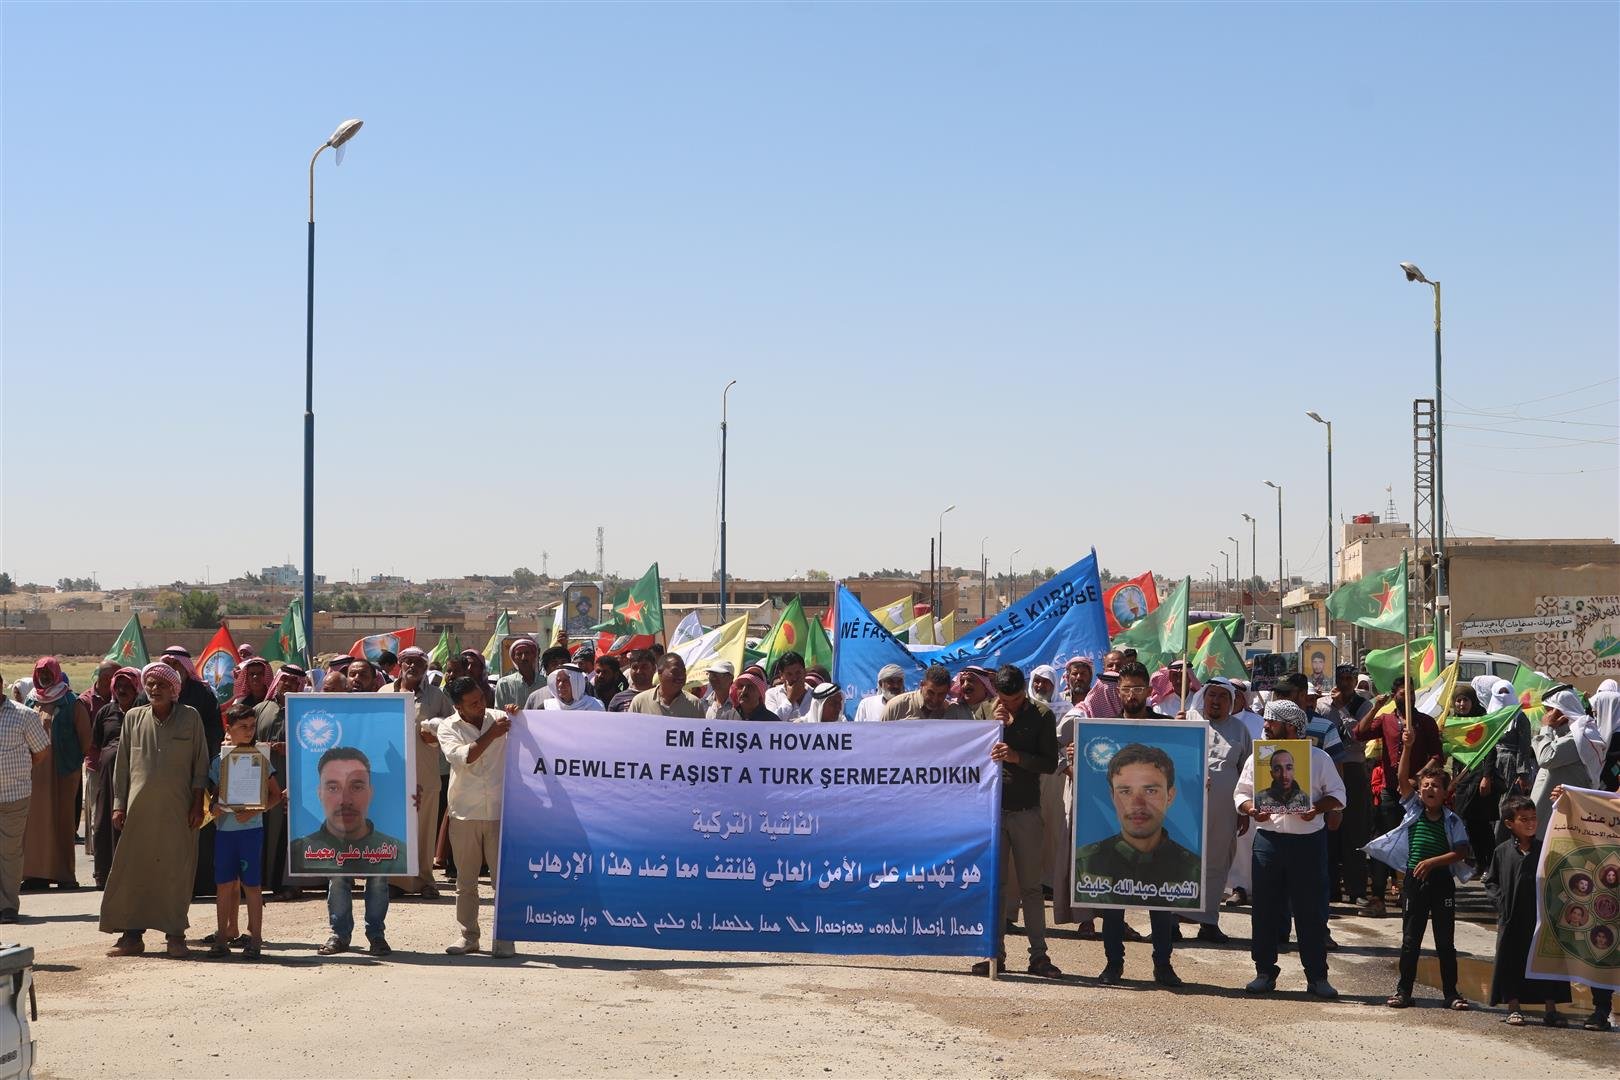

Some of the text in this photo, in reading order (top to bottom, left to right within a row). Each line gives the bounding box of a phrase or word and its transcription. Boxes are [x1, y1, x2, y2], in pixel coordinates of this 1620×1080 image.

[665, 728, 852, 753] EM ÊRIŞA HOVANE
[533, 758, 980, 788] A DEWLETA FAŞIST A TURK ŞERMEZARDIKIN
[692, 807, 819, 840] الفاشية التركية
[1580, 812, 1605, 824] عنف
[304, 842, 398, 866] الشهيد علي محمد
[528, 850, 981, 891] هو تهديد على الأمن العالمي فلنقف معا ضد هذا الإرهاب
[1076, 875, 1112, 897] خليف
[1158, 880, 1199, 902] الشهيد
